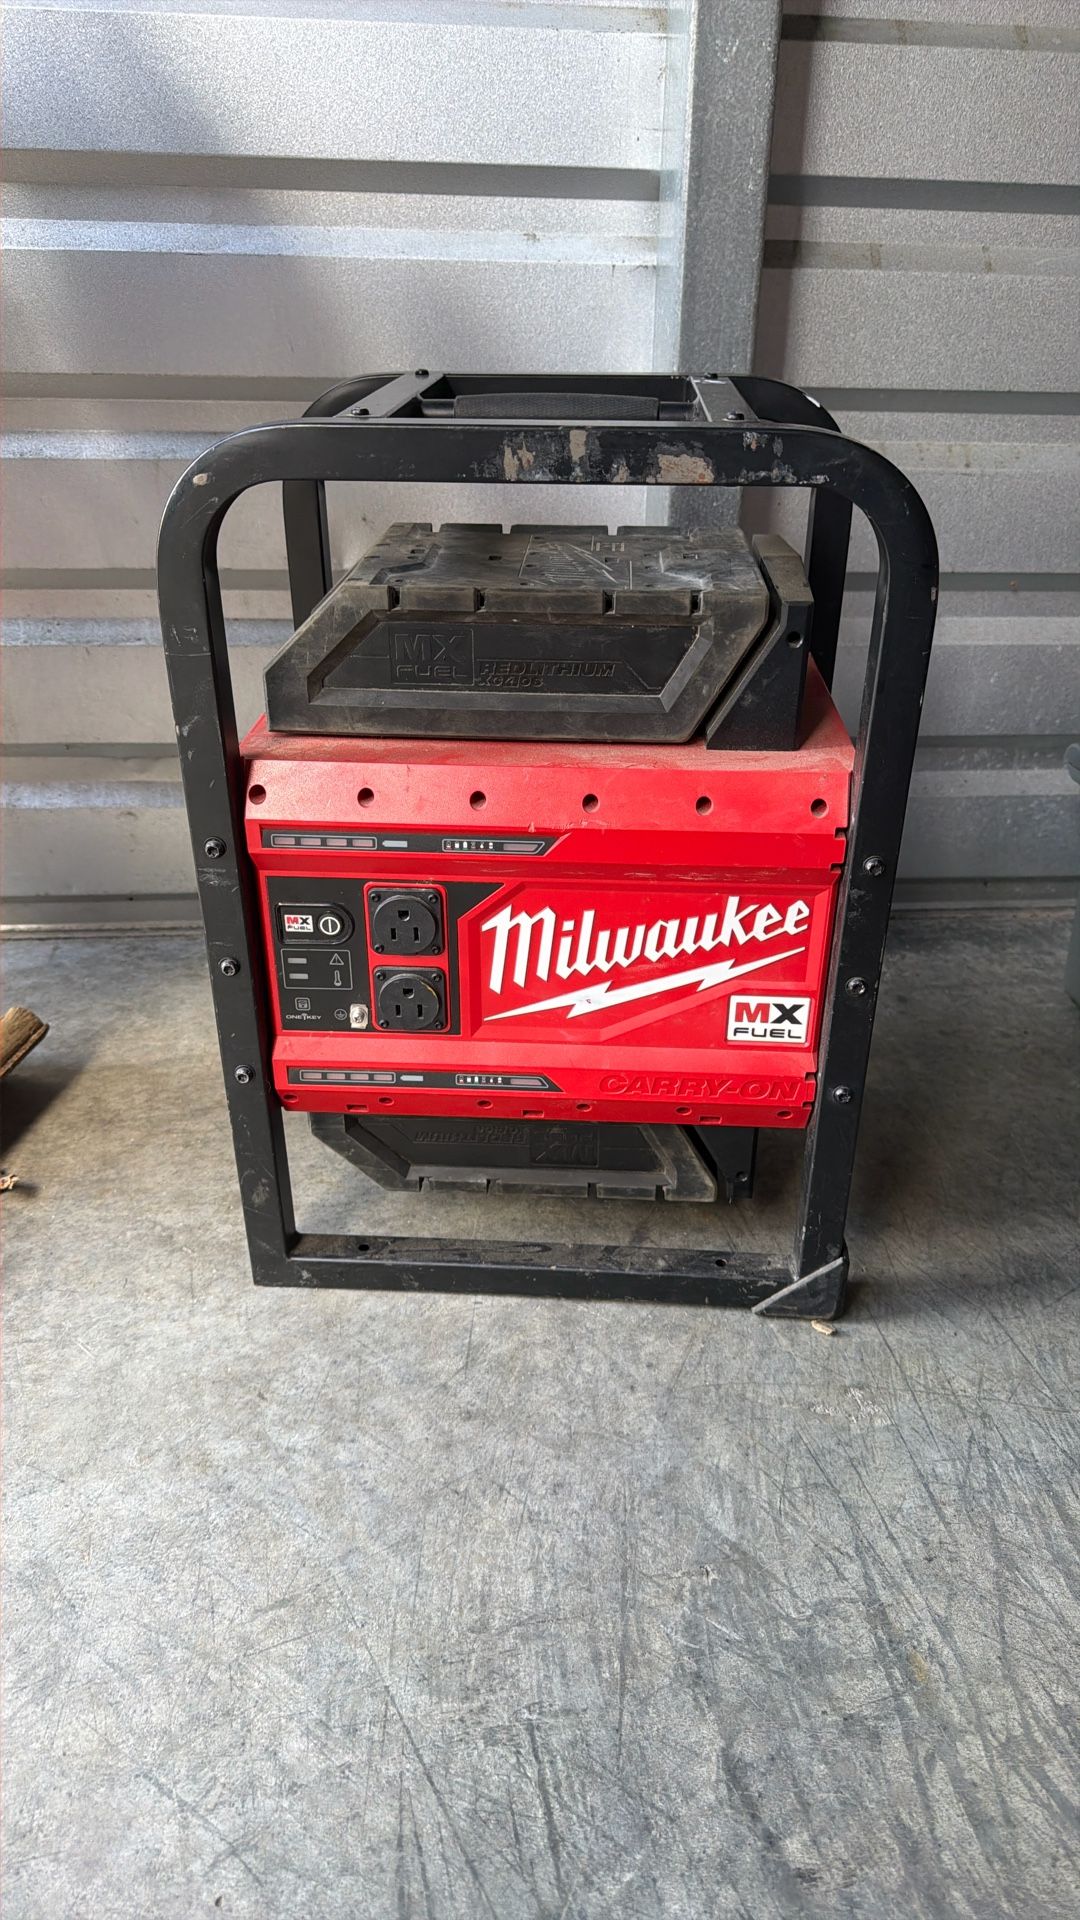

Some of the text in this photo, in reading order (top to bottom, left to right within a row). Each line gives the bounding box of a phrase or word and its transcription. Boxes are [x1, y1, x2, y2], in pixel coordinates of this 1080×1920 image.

[394, 633, 465, 662] MX
[395, 664, 468, 679] FUEL
[478, 661, 617, 677] REDLITHIUM
[286, 916, 310, 925] MX
[481, 895, 810, 994] Milwaukee
[734, 1001, 805, 1025] MX
[733, 1027, 802, 1039] FUEL
[599, 1074, 801, 1101] CARRY-ON
